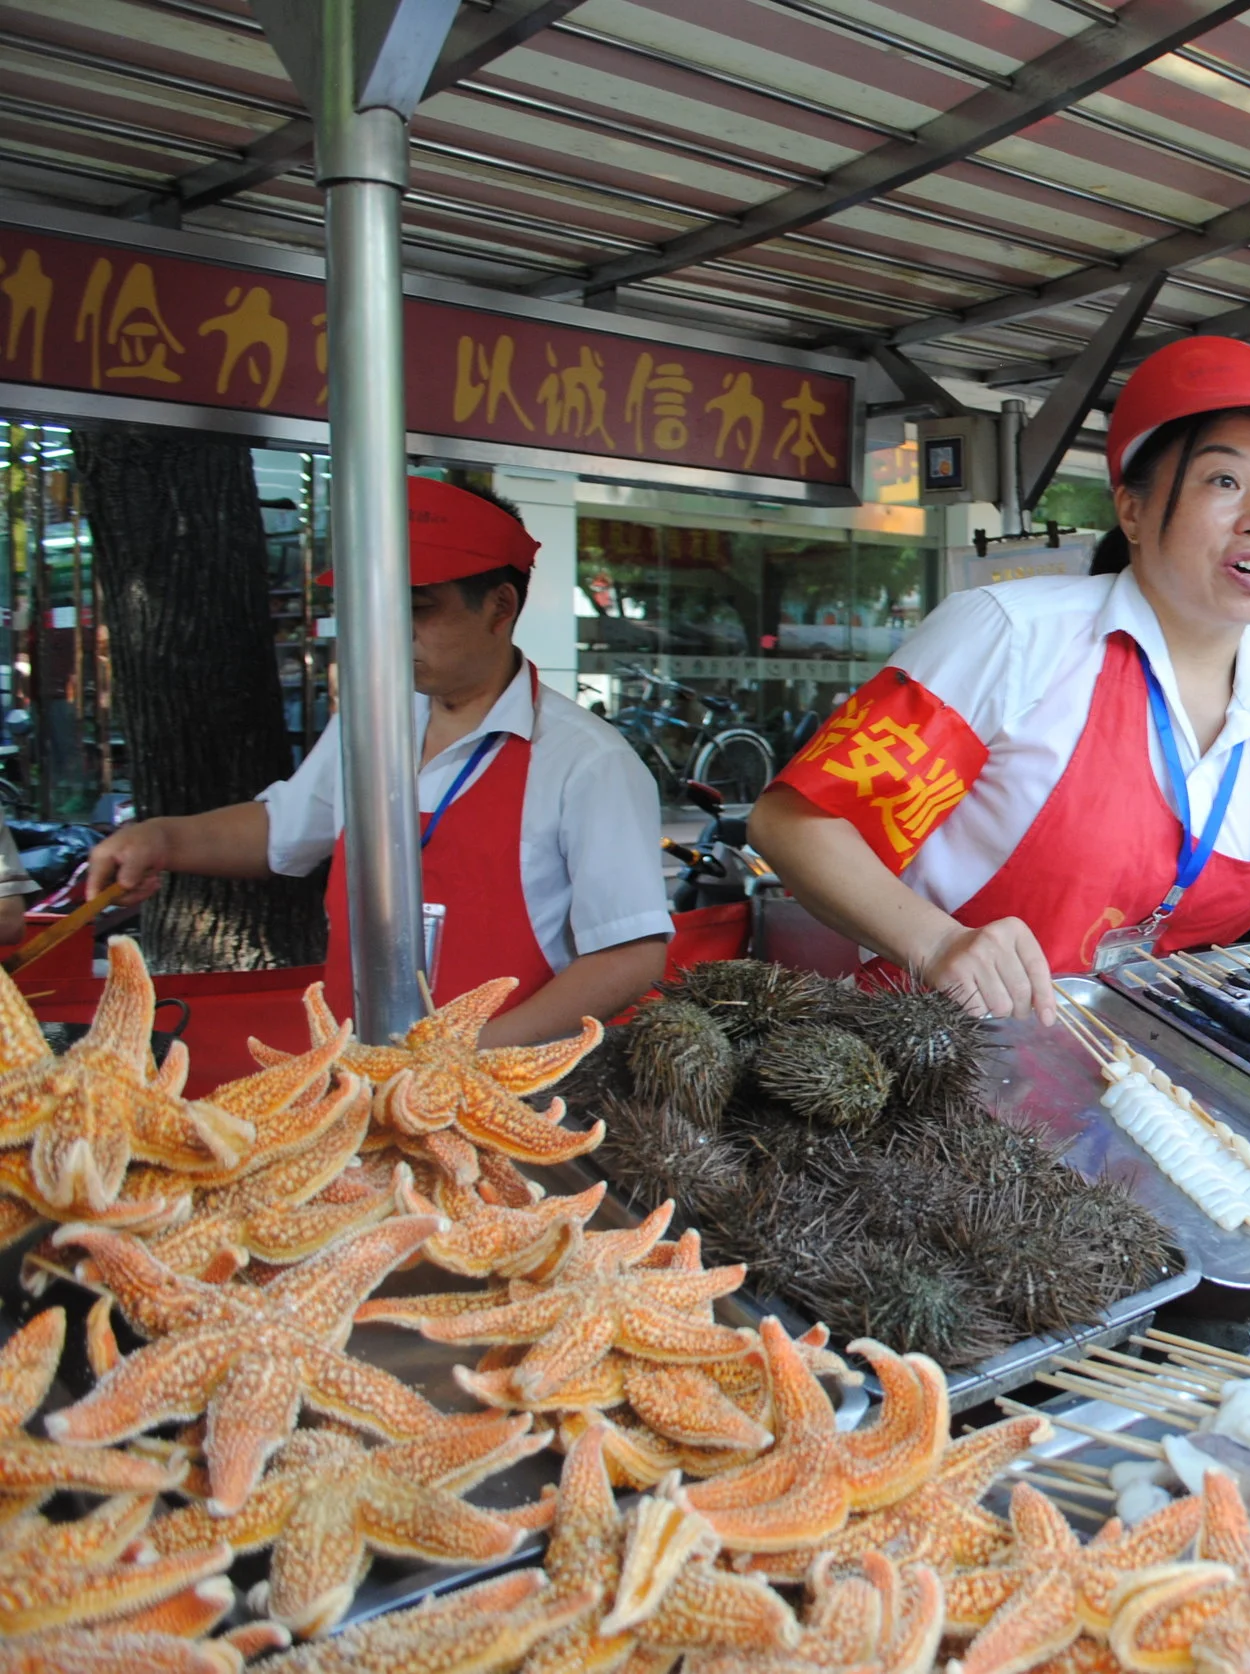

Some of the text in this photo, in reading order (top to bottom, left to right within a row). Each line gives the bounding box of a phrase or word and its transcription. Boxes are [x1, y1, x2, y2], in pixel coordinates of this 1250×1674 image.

[0, 248, 837, 476] 俭为 以诚信为本
[796, 695, 969, 870] 治安巡
